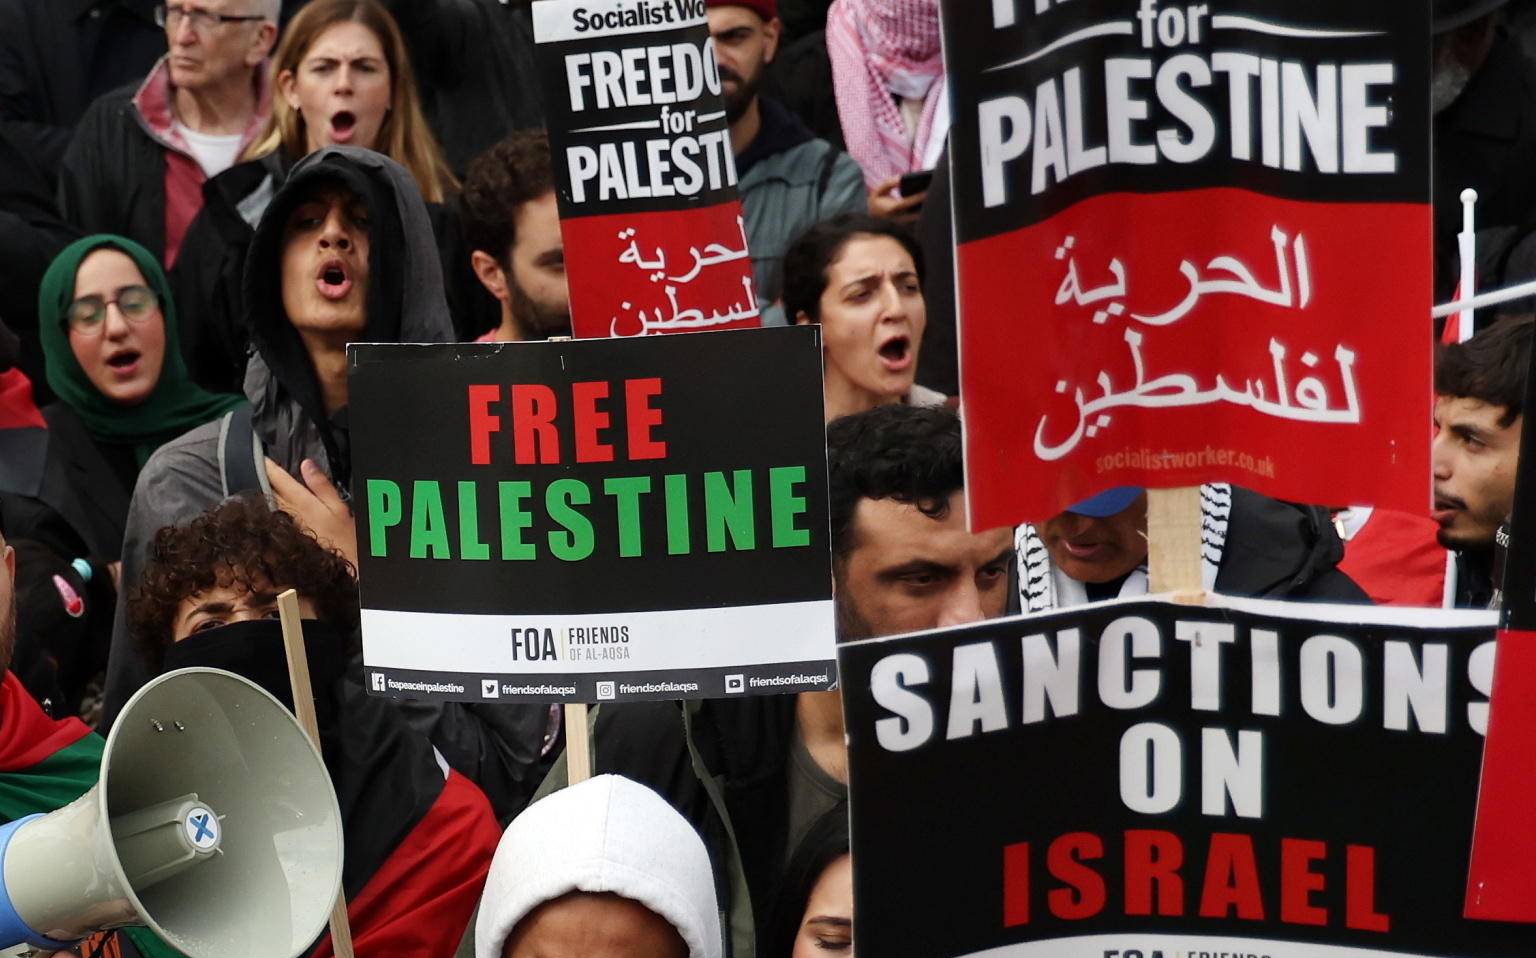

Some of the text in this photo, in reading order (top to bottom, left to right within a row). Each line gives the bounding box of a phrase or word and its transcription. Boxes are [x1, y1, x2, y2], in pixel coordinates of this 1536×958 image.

[573, 0, 674, 32] Socialist
[1137, 0, 1209, 48] for
[660, 105, 697, 135] for
[978, 52, 1396, 208] PALESTINE
[1054, 224, 1311, 326] الحرية
[1033, 327, 1360, 461] لفلسطين
[468, 377, 668, 465] FREE
[1095, 445, 1276, 479] socialistworker.co.uk
[366, 466, 811, 562] PALESTINE
[511, 628, 557, 661] FOA
[569, 626, 629, 645] FRIENDS
[570, 646, 630, 661] OF AL-AQSA
[388, 674, 828, 697] foapeaceinpalestine friendsofalaqsa friendsofalaqsa friendsofalaqsa
[1118, 722, 1263, 819] ON
[1003, 829, 1389, 933] ISRAEL
